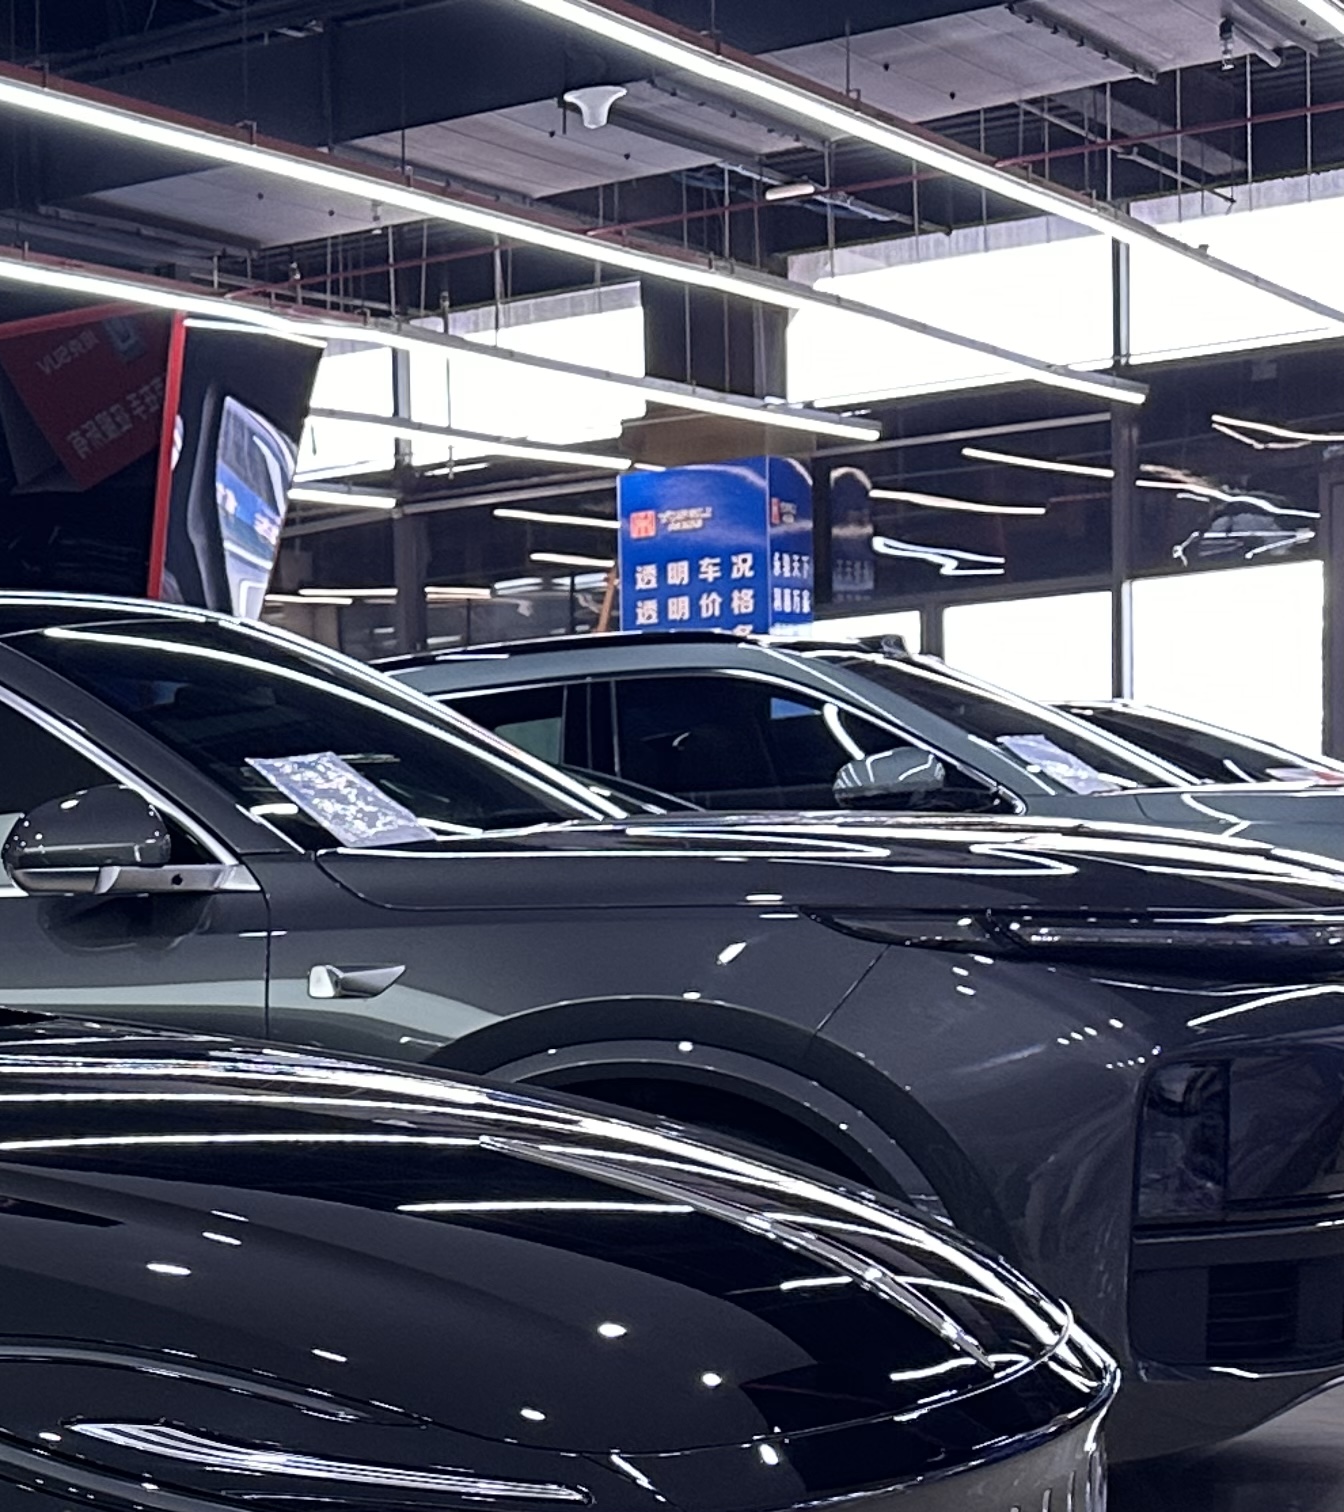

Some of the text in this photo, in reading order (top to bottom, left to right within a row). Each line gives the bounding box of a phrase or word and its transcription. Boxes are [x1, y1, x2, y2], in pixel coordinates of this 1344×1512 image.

[634, 552, 755, 591] 透明车况
[634, 588, 755, 626] 透明价格
